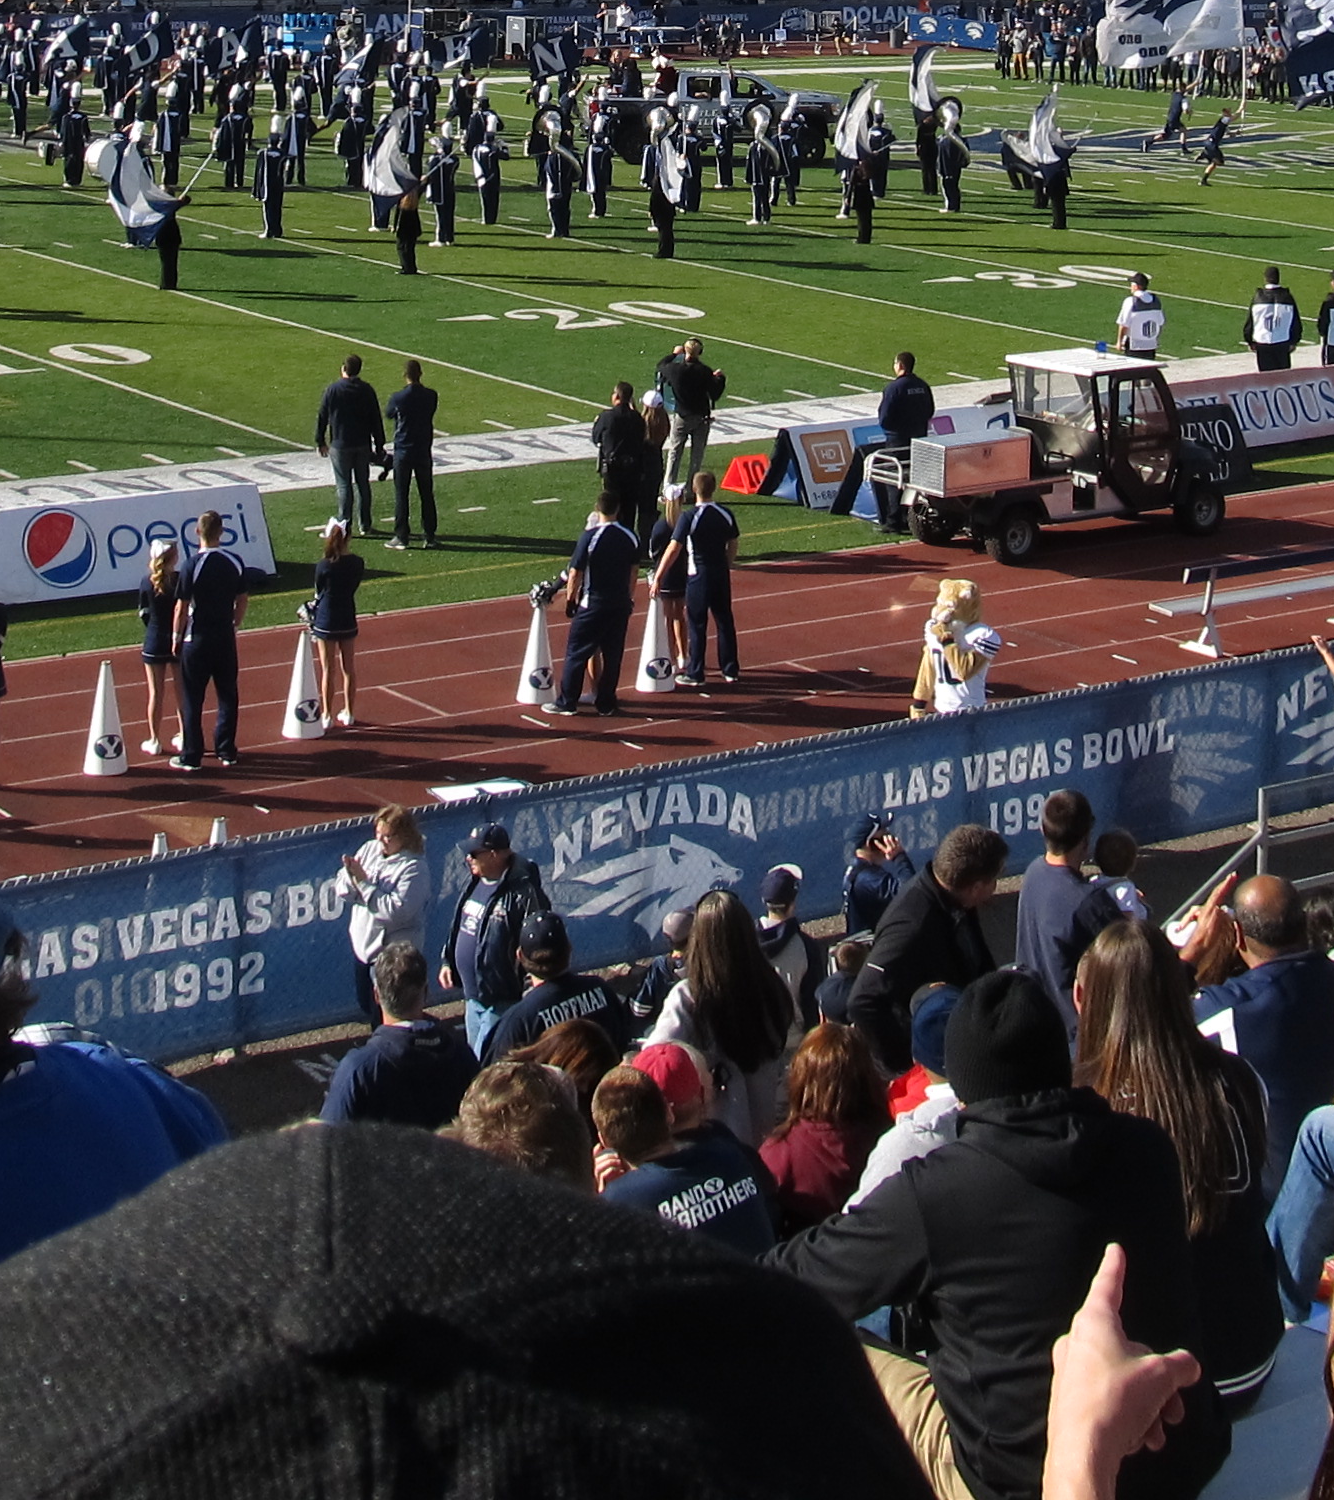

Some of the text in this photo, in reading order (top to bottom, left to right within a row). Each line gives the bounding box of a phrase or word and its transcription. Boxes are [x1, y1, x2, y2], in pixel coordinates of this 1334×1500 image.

[974, 264, 1153, 289] 30
[503, 300, 707, 330] 20
[820, 446, 837, 461] HD
[107, 503, 251, 570] pepsi
[882, 761, 951, 810] LAS
[964, 739, 1073, 793] VEGAS
[1082, 717, 1176, 769] BOWL
[551, 784, 757, 878] NEVADA
[988, 791, 1059, 838] 199
[20, 924, 101, 978] AS
[117, 891, 272, 961] VEGAS
[152, 950, 266, 1013] 1992
[538, 986, 608, 1029] HOFFMAN
[658, 1187, 705, 1220] BAND
[677, 1177, 758, 1230] BROTHERS
